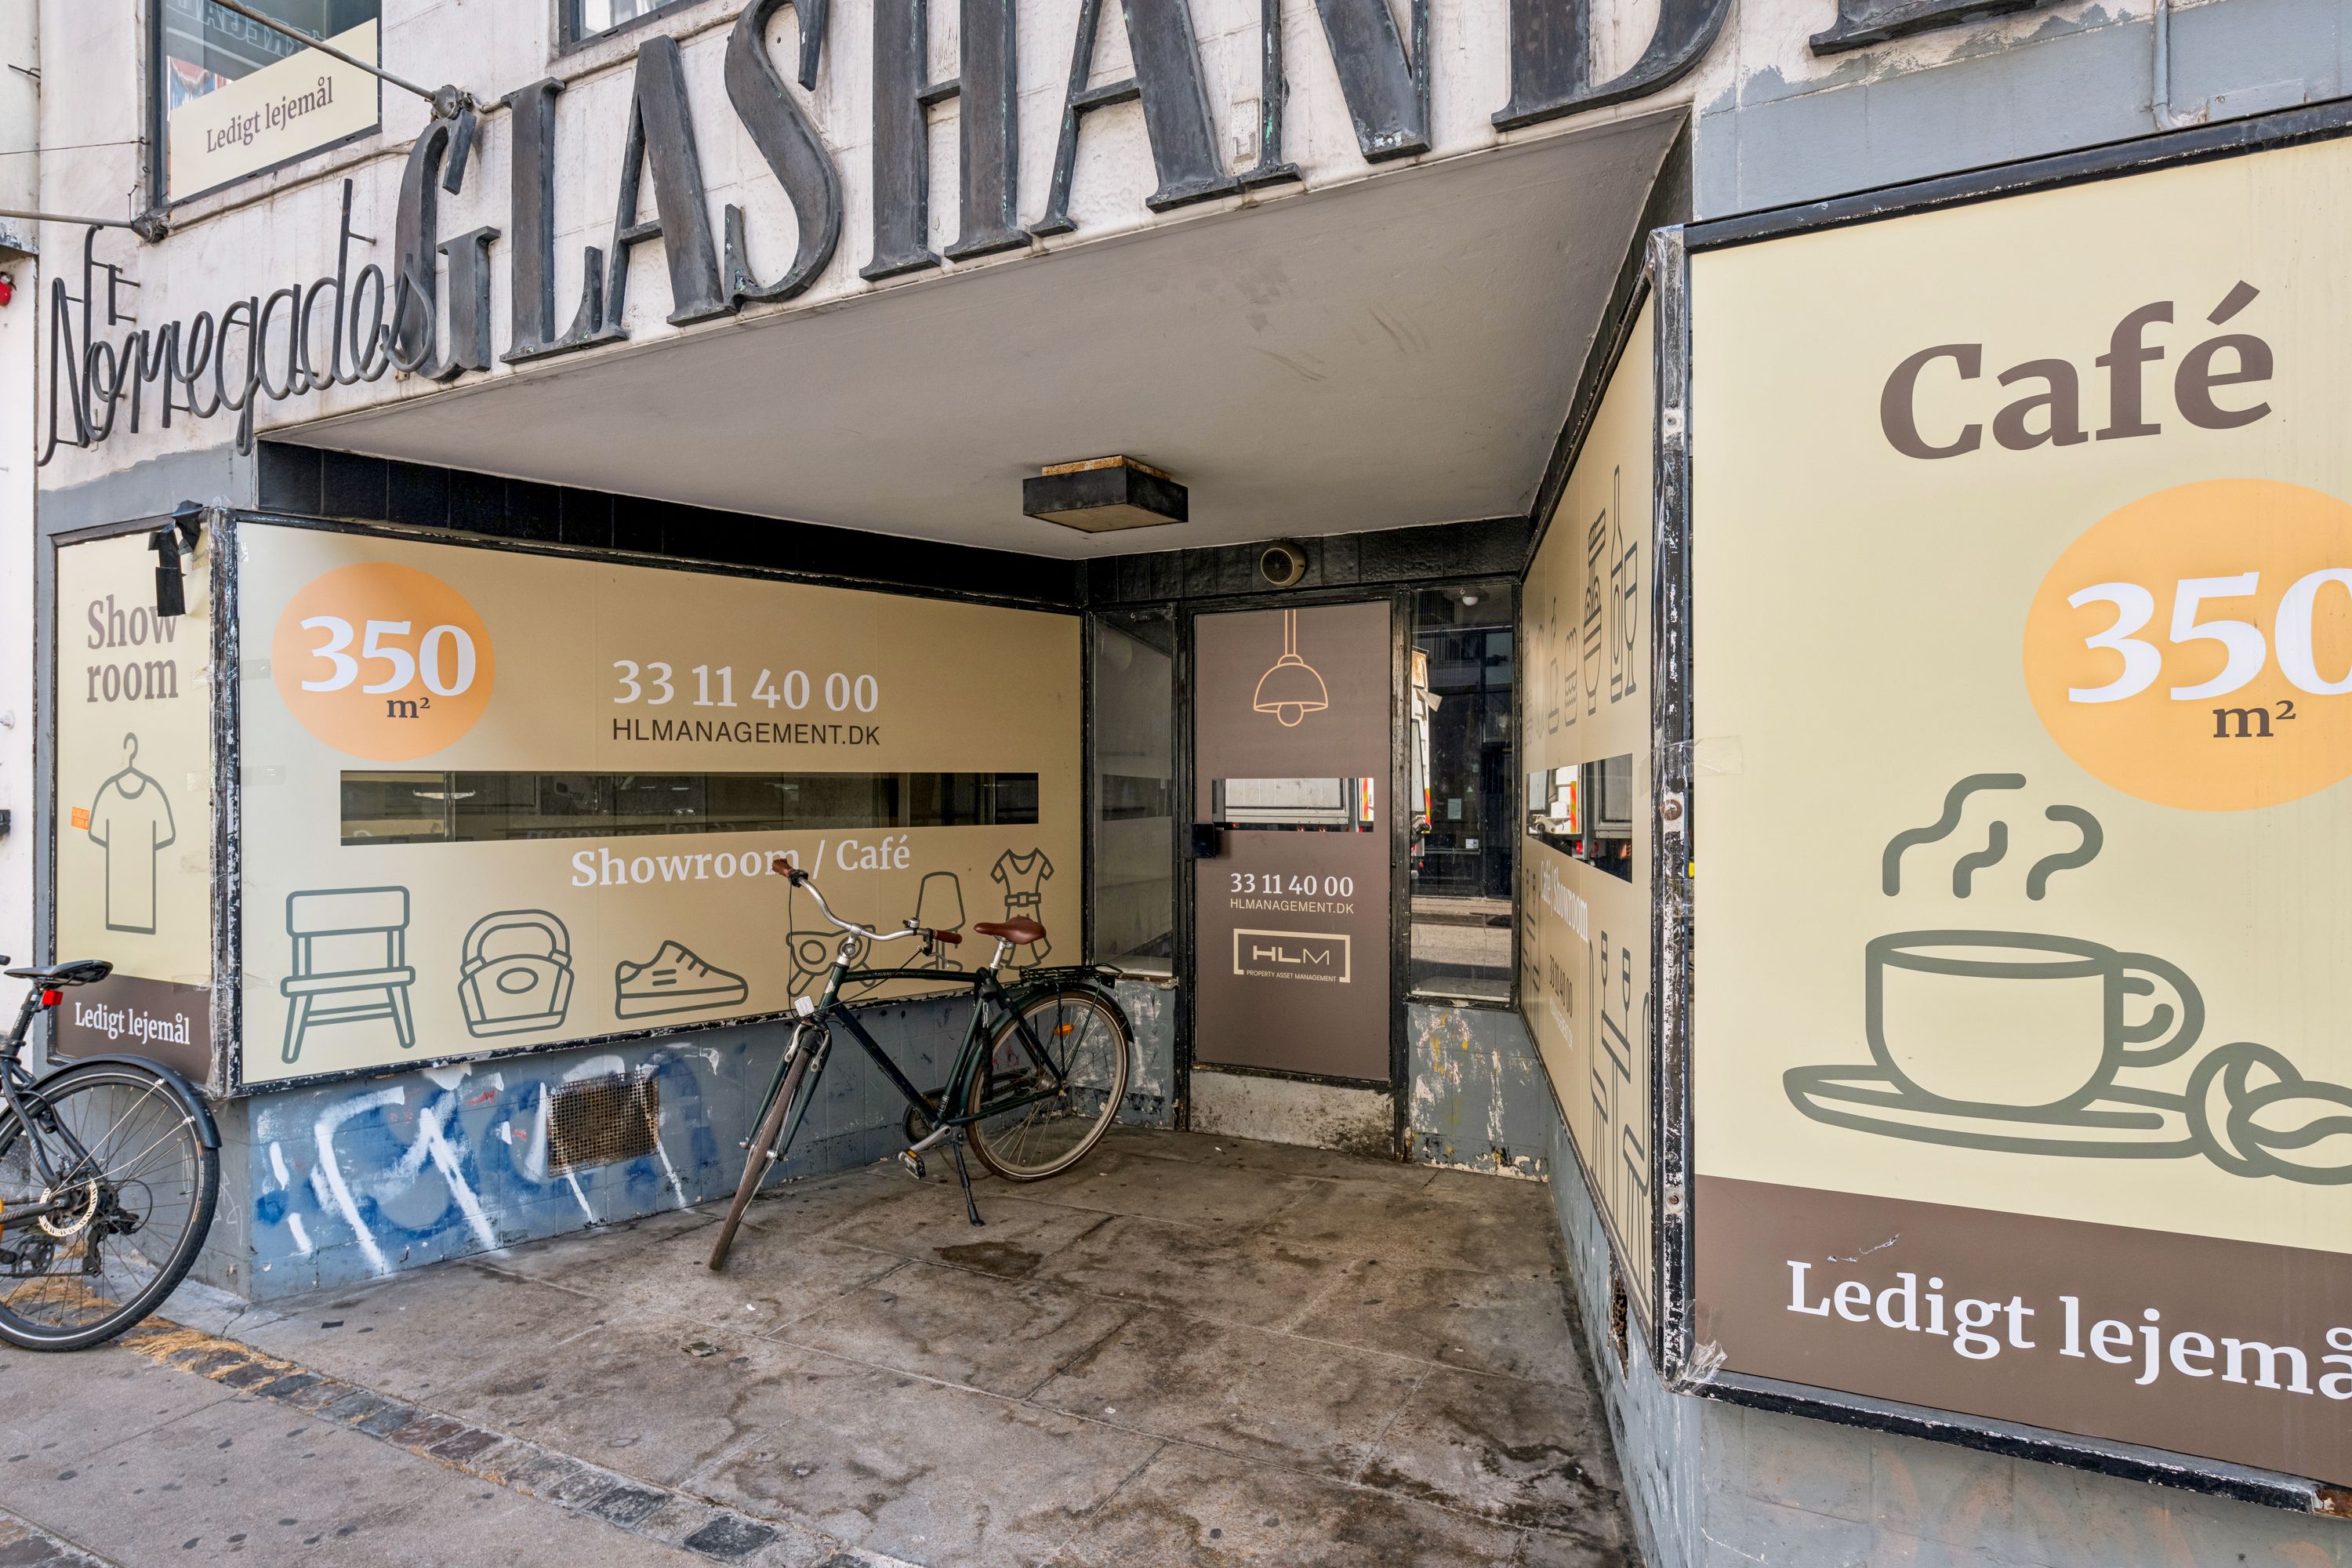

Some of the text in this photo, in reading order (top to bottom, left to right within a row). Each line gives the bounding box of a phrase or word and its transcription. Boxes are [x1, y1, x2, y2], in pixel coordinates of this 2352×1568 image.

[205, 76, 334, 154] Ledigt lejemål
[1880, 280, 2274, 460] Café
[87, 593, 176, 650] Show
[2066, 568, 2352, 703] 350
[300, 616, 476, 696] 350
[86, 660, 178, 702] room
[612, 659, 878, 713] 33 11 40 00
[387, 696, 430, 719] m²
[2212, 699, 2296, 739] m²
[612, 718, 880, 746] HLMANAGEMENT.DK
[572, 834, 911, 887] Showroom / Café
[1230, 873, 1354, 897] 33 11 40 00
[1230, 898, 1354, 914] HLMANAGEMENT.DK
[1554, 866, 1588, 943] Showroom
[1247, 969, 1275, 978] PROPERTY
[1294, 973, 1337, 982] MANAGEMENT
[1253, 946, 1330, 965] HLM
[74, 1002, 125, 1040] Ledigt
[128, 1005, 190, 1045] lejemål
[1786, 1260, 2036, 1360] Ledigt
